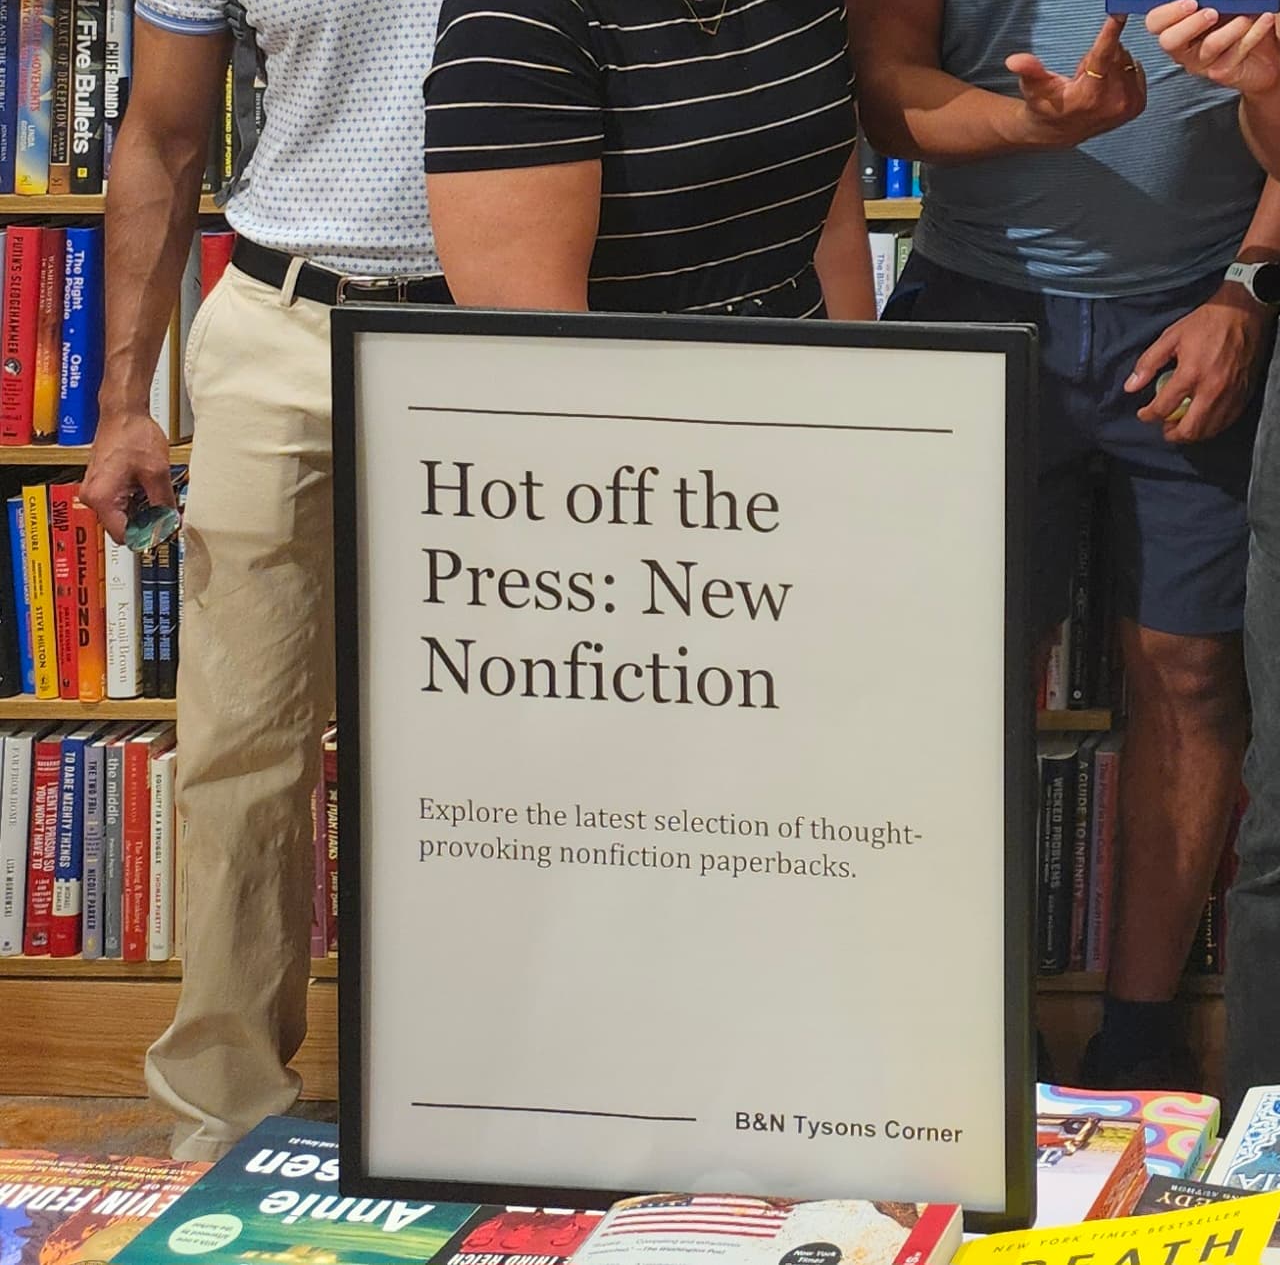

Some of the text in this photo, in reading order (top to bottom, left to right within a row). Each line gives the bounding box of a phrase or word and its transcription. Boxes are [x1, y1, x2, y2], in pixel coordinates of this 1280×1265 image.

[73, 20, 98, 154] Five Bullets
[418, 459, 781, 533] Hot off the
[77, 527, 89, 647] DEFUND
[420, 547, 794, 622] Press: New
[420, 636, 781, 709] Nonfiction
[418, 838, 857, 880] provoking nonfiction paperbacks.
[419, 797, 923, 850] Explore the latest selection of thought-
[735, 1111, 963, 1143] B&N Tysons Corner
[259, 1190, 434, 1233] Annie
